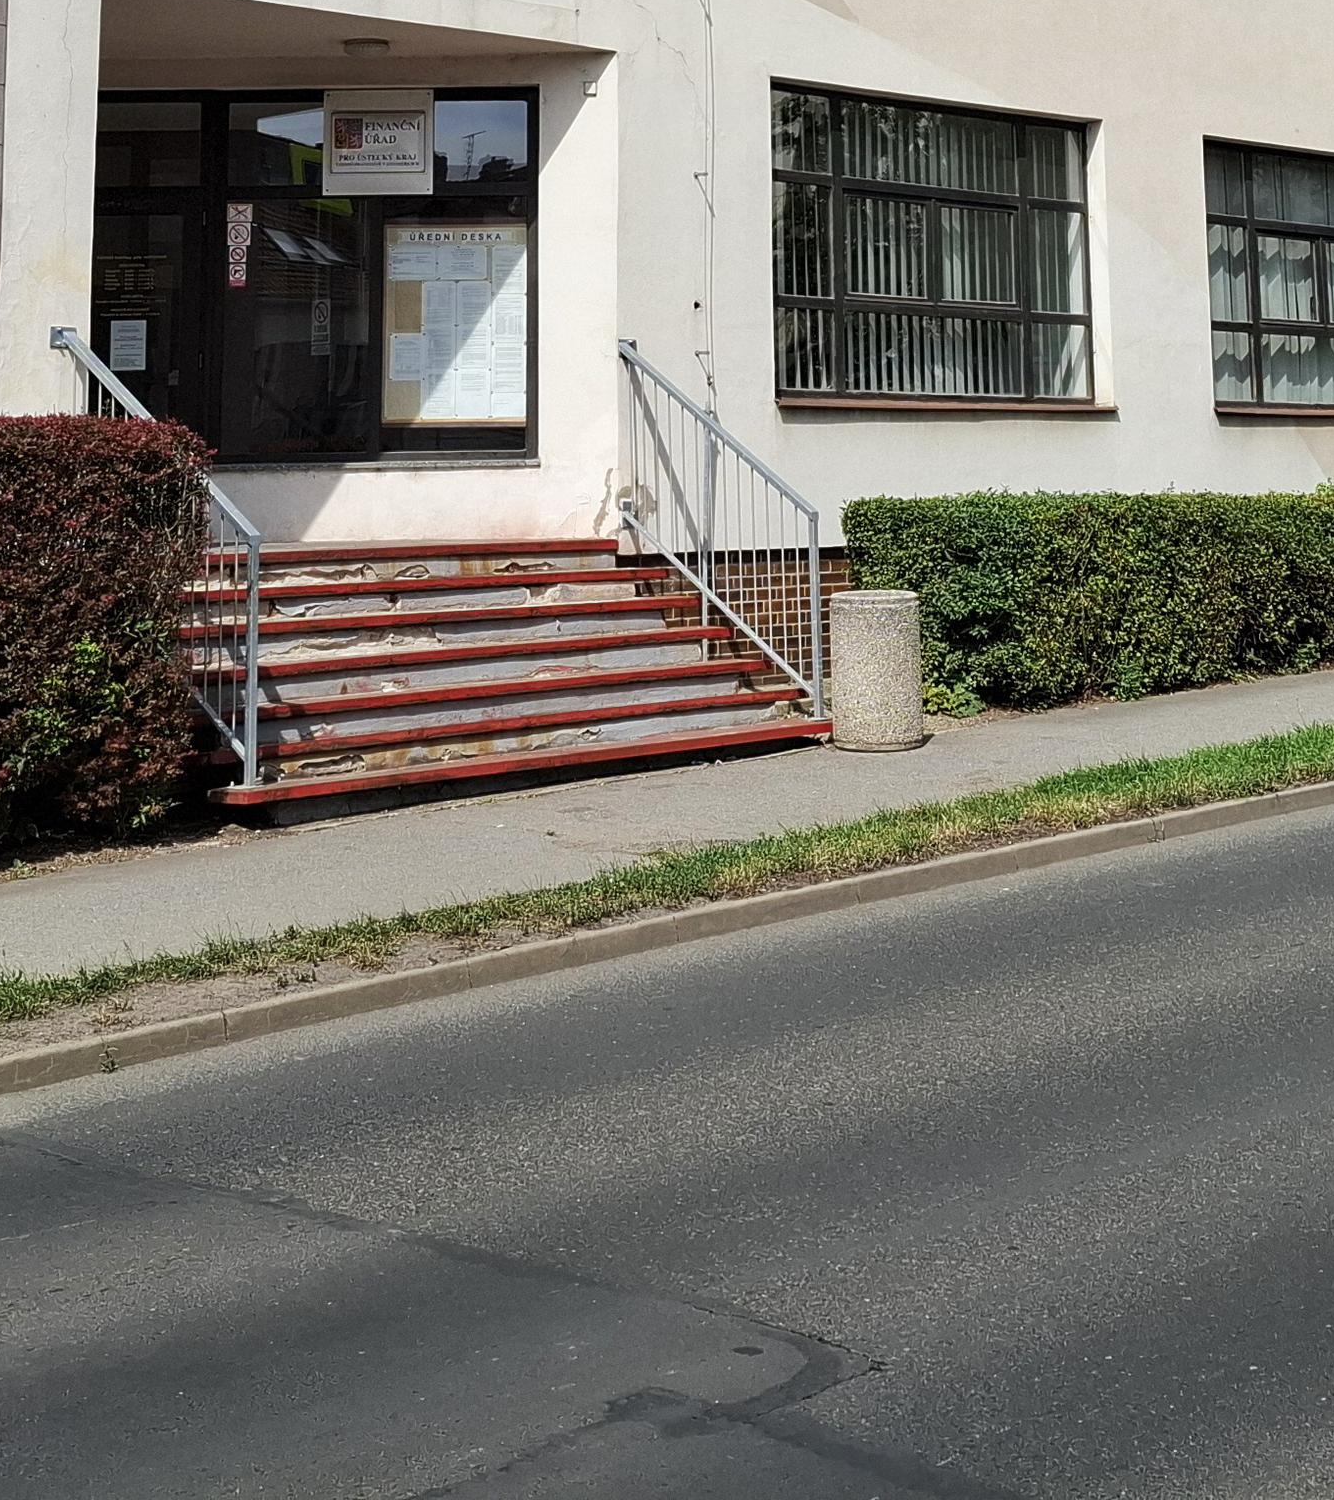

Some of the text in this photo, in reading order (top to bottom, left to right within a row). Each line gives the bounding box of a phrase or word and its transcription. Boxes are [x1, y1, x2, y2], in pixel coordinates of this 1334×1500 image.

[364, 119, 420, 131] FINANČNÍ
[364, 133, 397, 144] ÚŘAD
[396, 153, 417, 161] KRAJ
[409, 230, 502, 241] ÚŘEDNÍ DESKA
